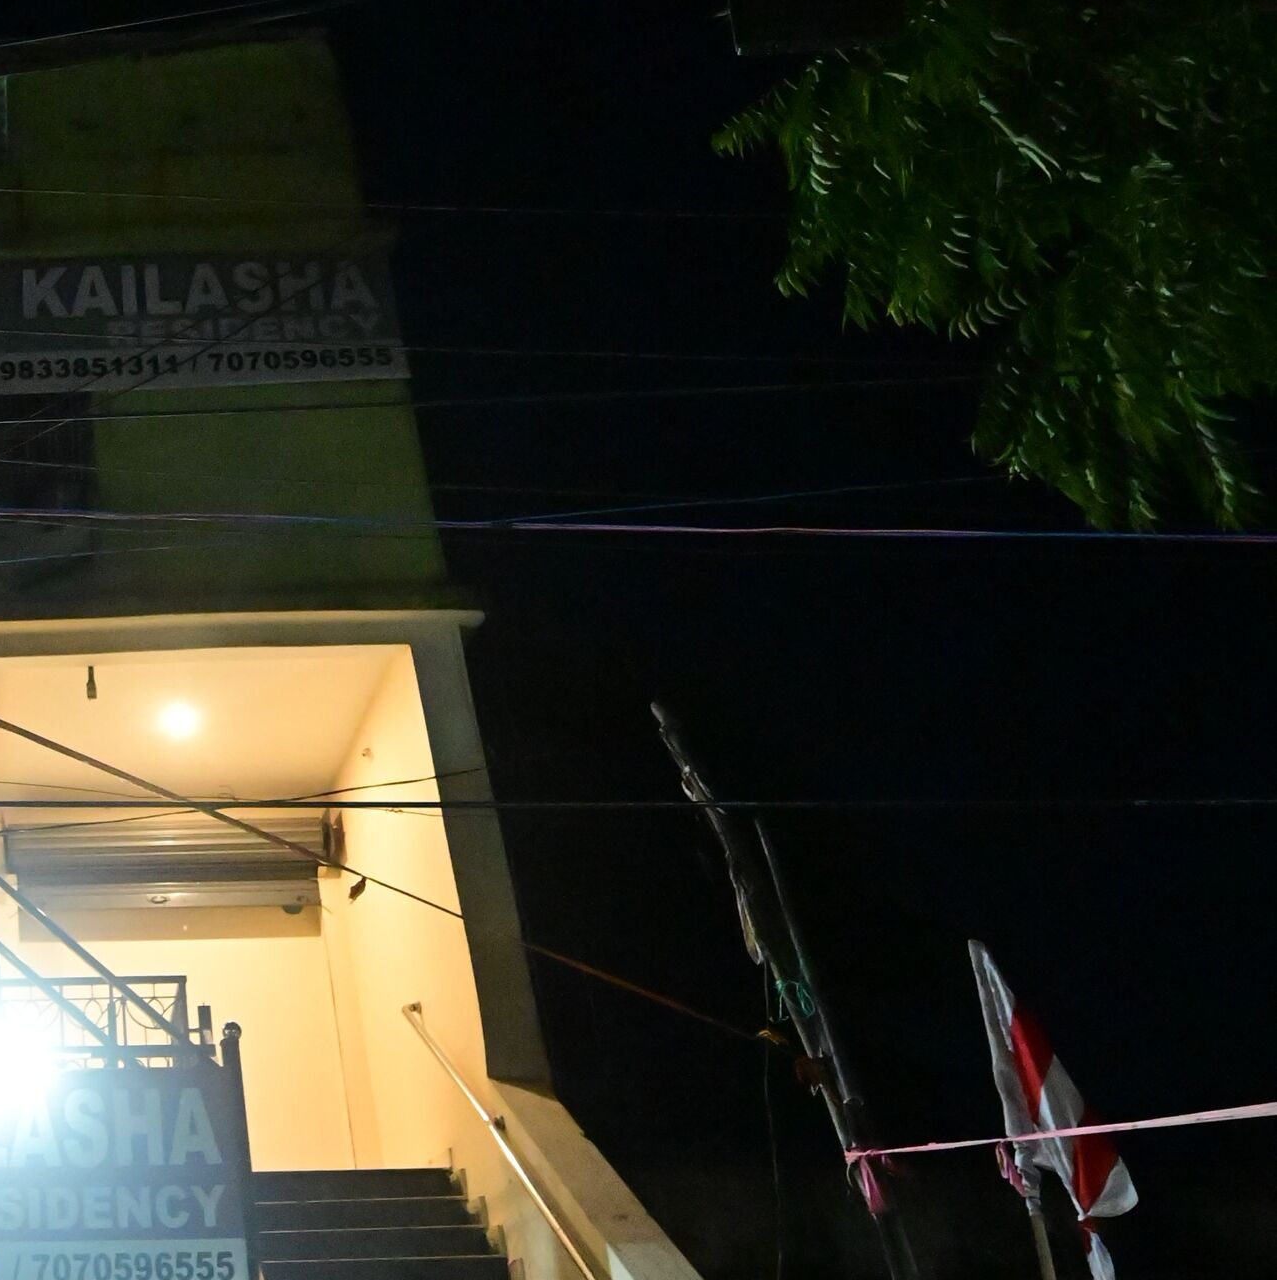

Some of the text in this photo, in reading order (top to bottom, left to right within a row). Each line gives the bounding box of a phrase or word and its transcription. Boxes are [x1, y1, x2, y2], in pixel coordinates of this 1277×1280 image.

[21, 262, 377, 319] KAILASHA
[109, 315, 380, 344] RESIDENCY
[0, 353, 179, 380] 9833851311
[207, 347, 393, 372] 7070596555
